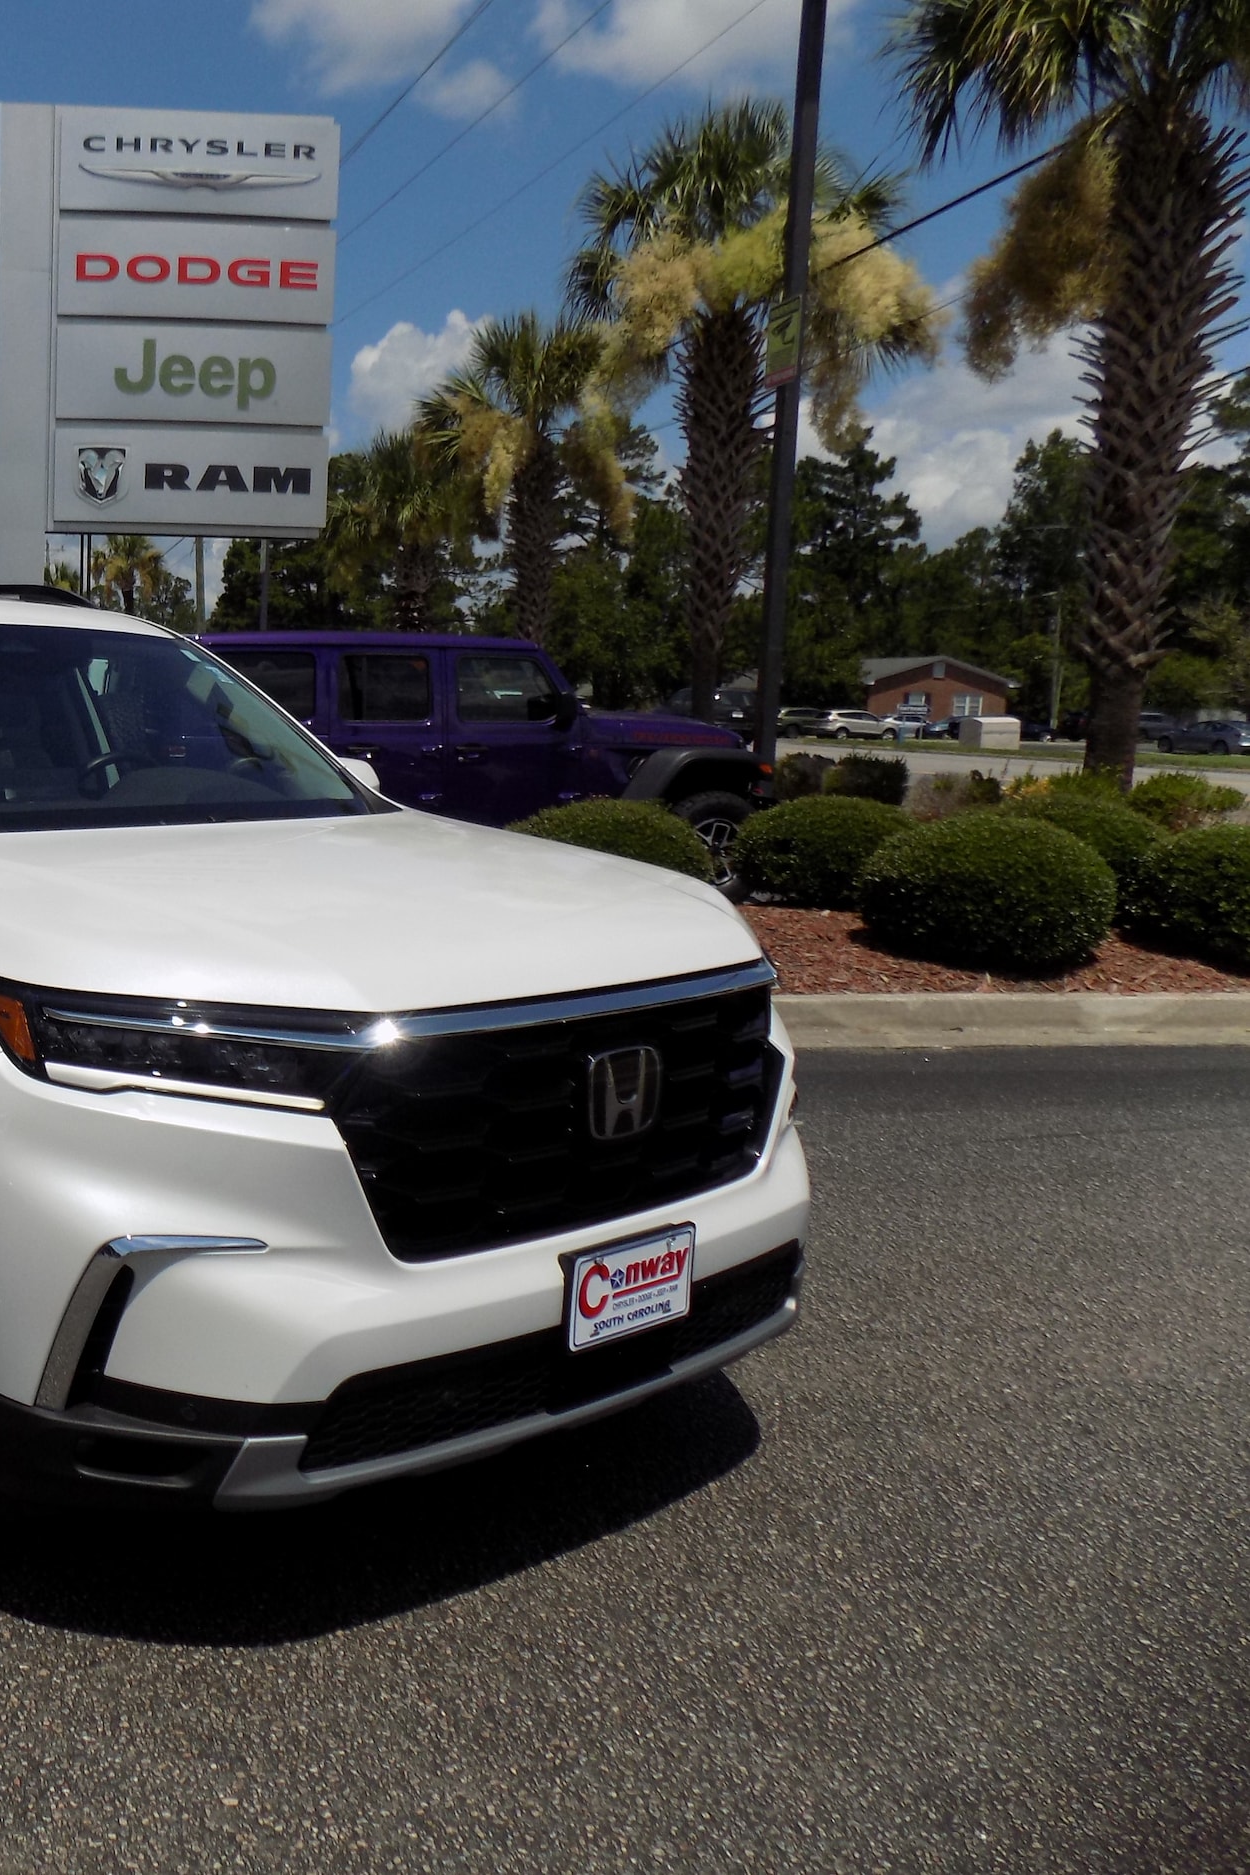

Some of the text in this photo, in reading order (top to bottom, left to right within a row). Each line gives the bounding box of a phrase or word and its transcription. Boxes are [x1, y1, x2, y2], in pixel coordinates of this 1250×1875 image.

[82, 135, 317, 161] CHRYSLER
[75, 252, 319, 291] DODGE
[113, 337, 277, 411] Jeep
[143, 462, 312, 495] RAM
[593, 1300, 671, 1332] SOUTH CAROLINA
